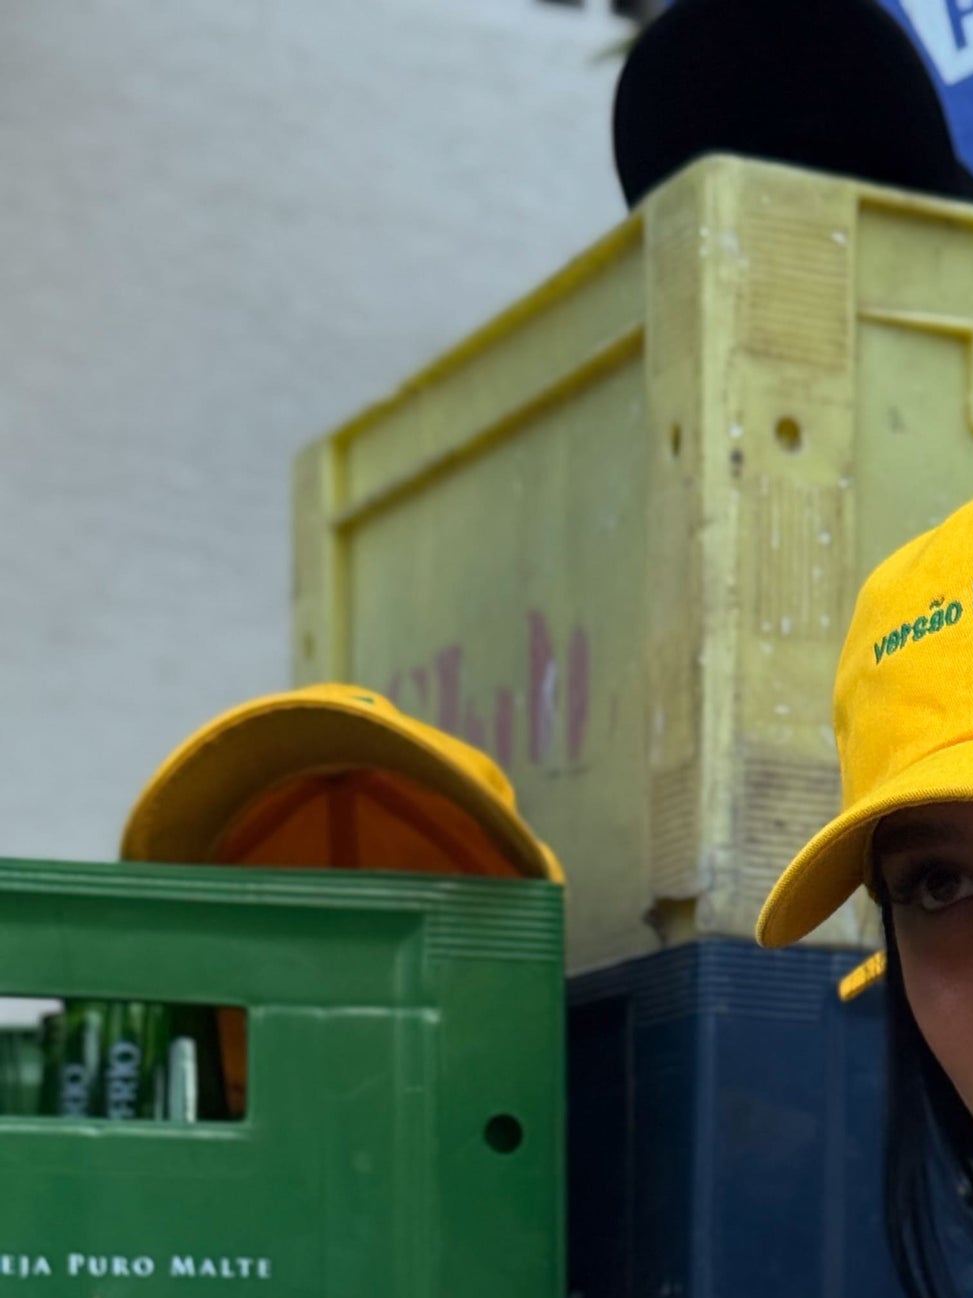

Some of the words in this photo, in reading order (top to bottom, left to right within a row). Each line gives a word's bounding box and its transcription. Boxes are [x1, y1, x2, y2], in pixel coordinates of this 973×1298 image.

[873, 596, 964, 665] versão
[68, 1253, 155, 1277] PURO
[171, 1255, 271, 1279] MALTE
